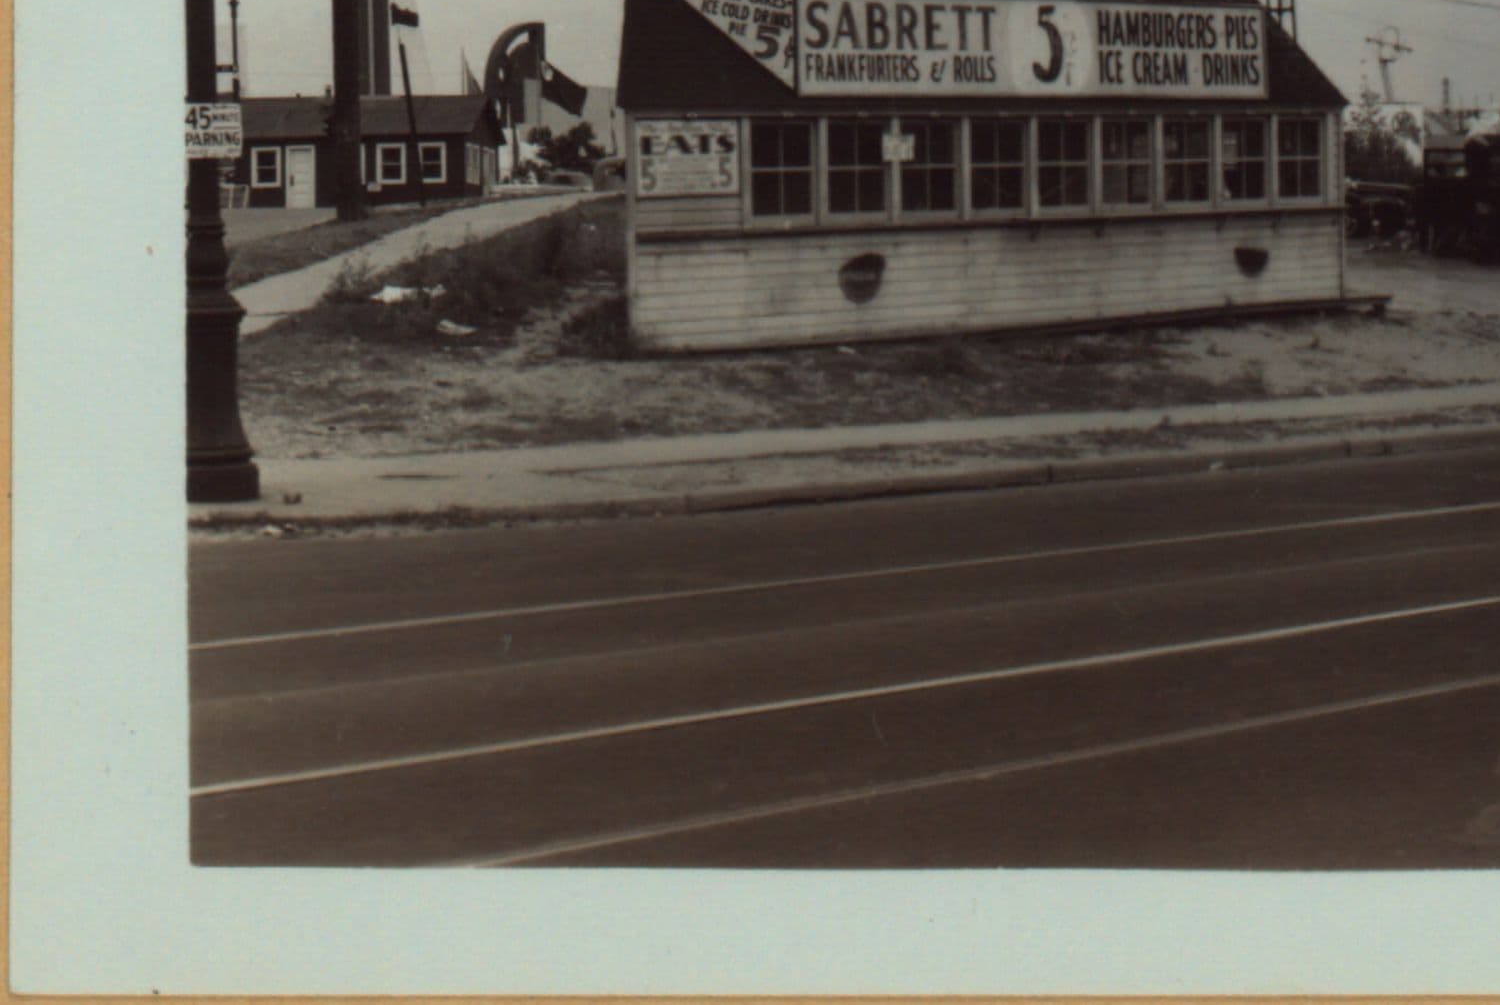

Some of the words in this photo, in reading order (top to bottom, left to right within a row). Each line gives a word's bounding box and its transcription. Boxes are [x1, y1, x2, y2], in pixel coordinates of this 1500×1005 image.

[721, 2, 749, 21] COLD
[805, 0, 996, 51] SABRETT
[728, 21, 747, 36] PIE
[1097, 10, 1217, 49] HAMBURGERS
[1224, 15, 1258, 50] PIES
[806, 54, 920, 82] FRANKFURTERS
[953, 55, 997, 83] ROLLS
[1099, 50, 1124, 84] ICE
[1132, 51, 1188, 85] CREAM
[1203, 54, 1260, 86] DRINKS
[185, 106, 211, 130] 45
[185, 131, 241, 147] PARKING
[640, 134, 735, 155] EATS
[641, 159, 657, 191] 5
[719, 156, 733, 187] 5
